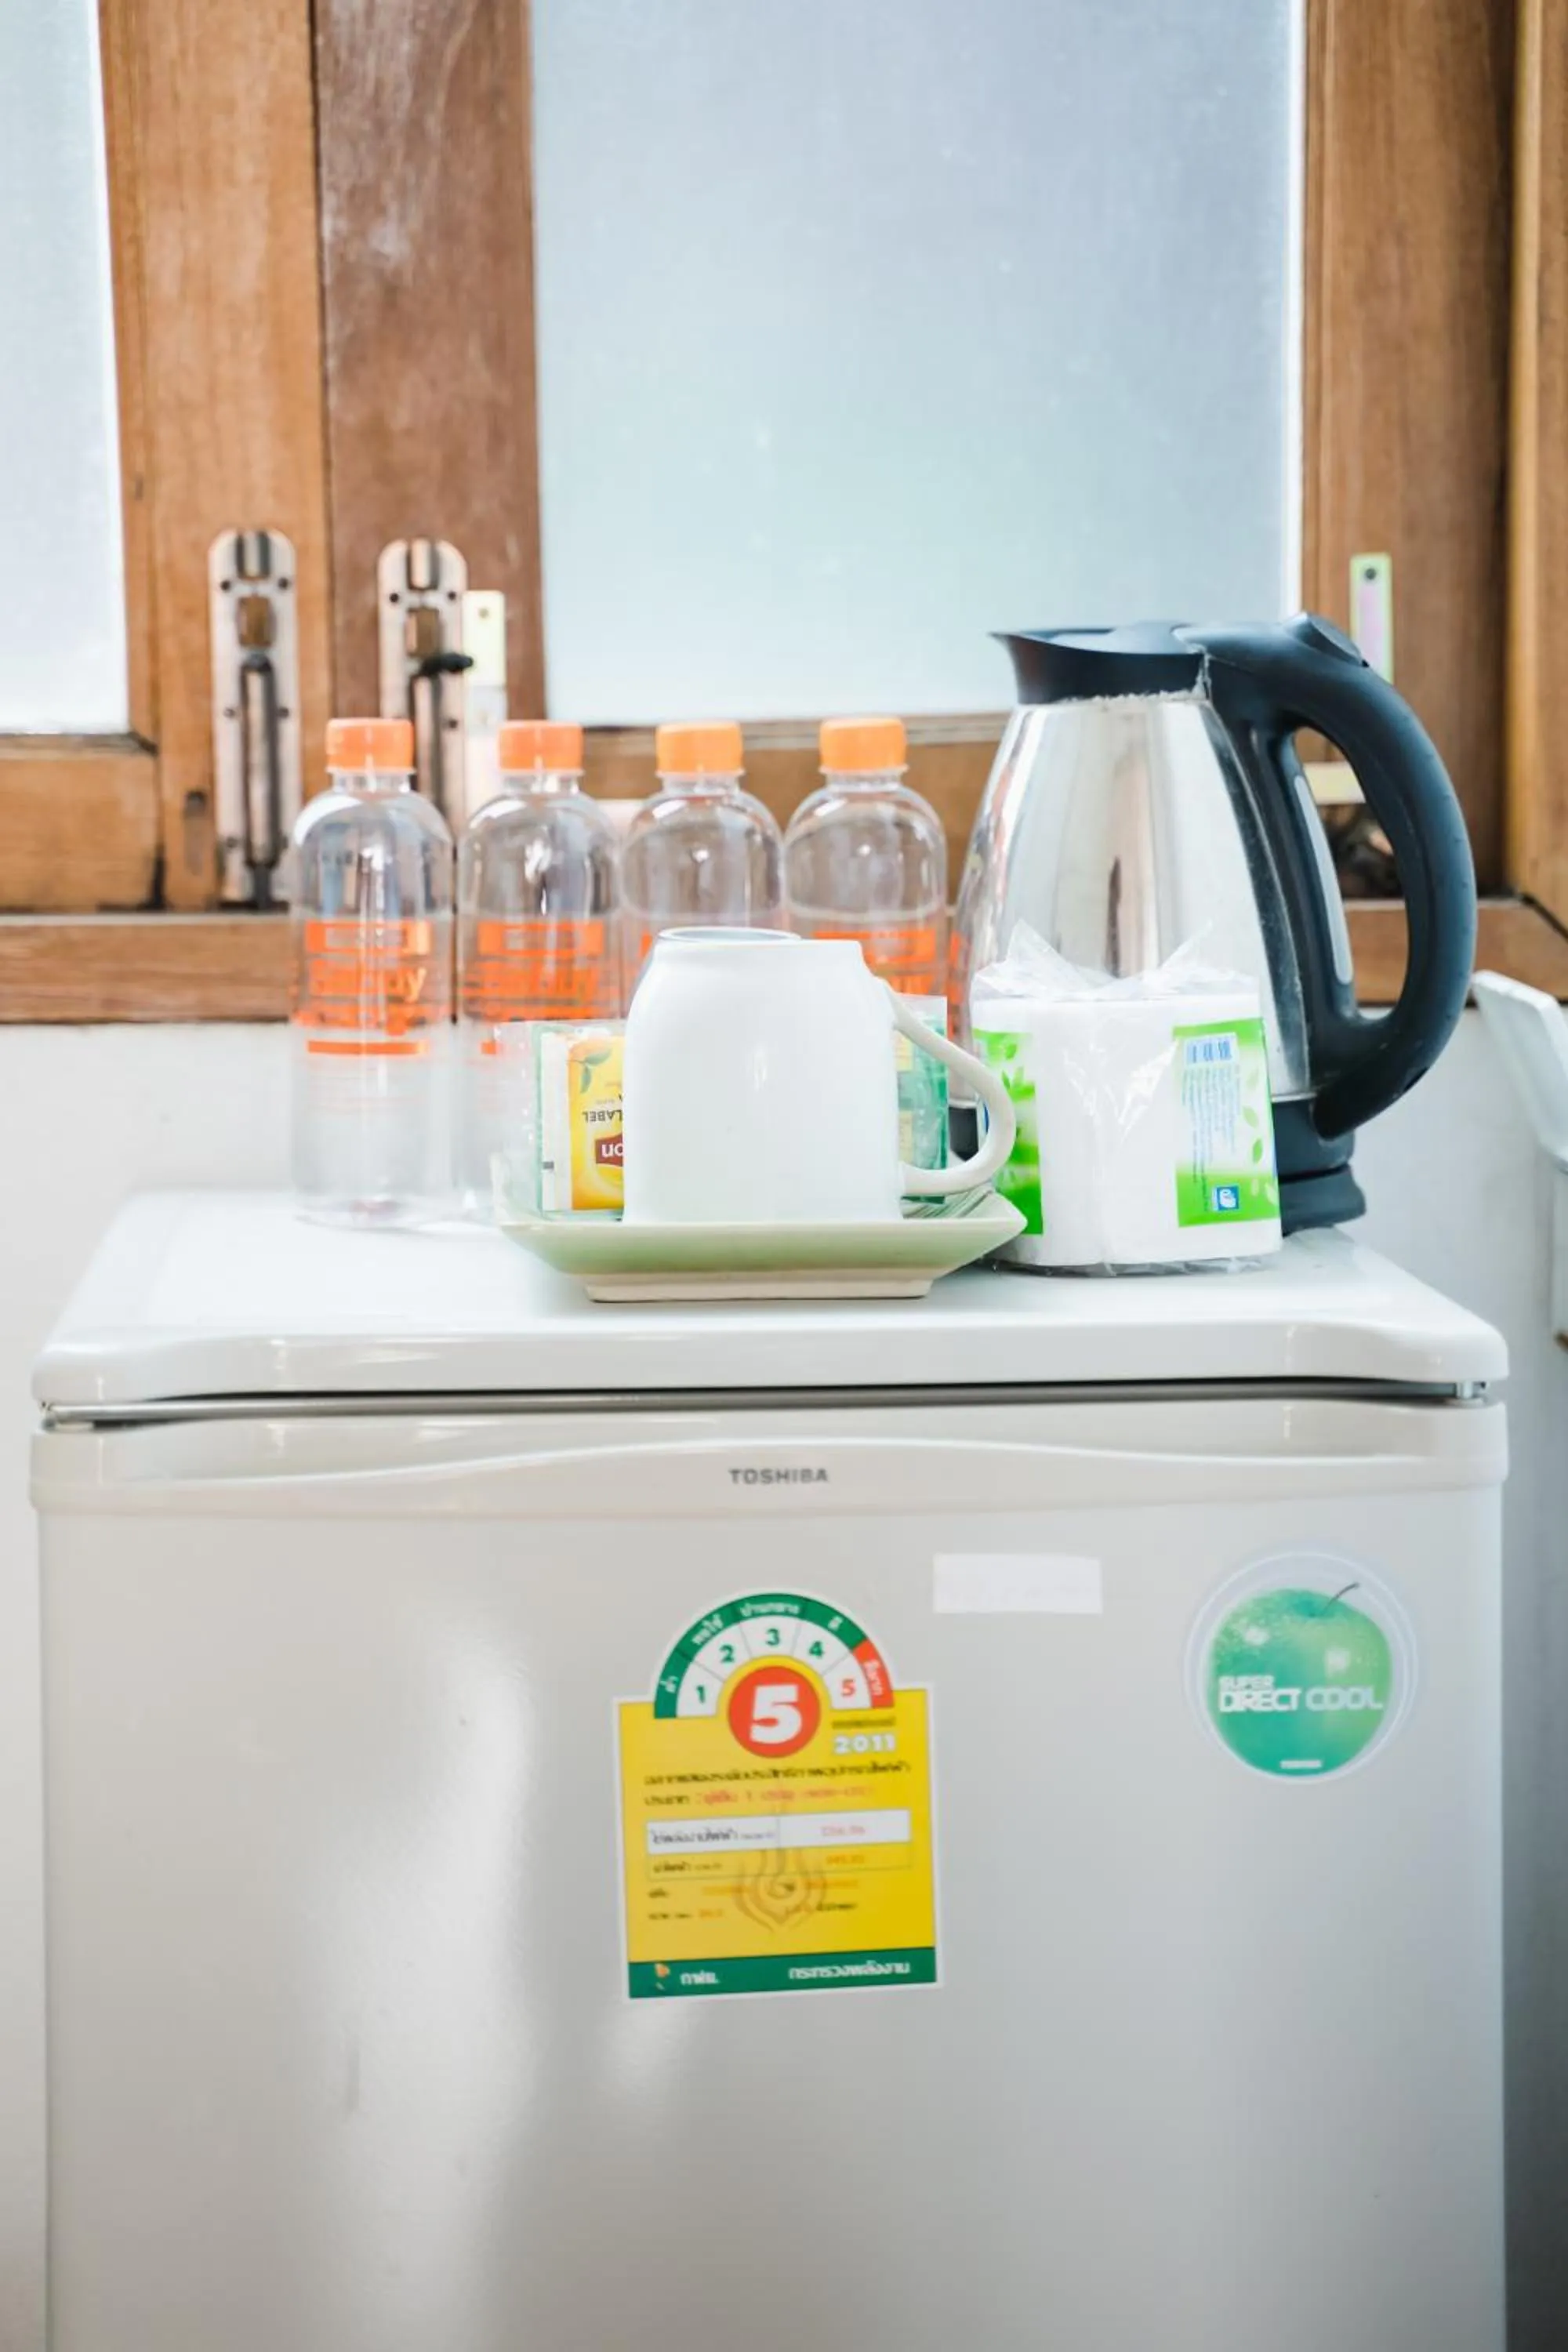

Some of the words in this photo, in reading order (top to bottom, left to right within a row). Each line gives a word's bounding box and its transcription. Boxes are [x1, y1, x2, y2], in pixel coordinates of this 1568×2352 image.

[582, 1110, 622, 1123] LABEL
[728, 1468, 829, 1484] TOSHIBA
[696, 1685, 706, 1704] 1
[720, 1645, 735, 1663] 2
[765, 1628, 780, 1646] 3
[808, 1641, 825, 1658] 4
[840, 1679, 855, 1697] 5
[1219, 1688, 1301, 1712] DIRECT
[1305, 1687, 1383, 1711] COOL
[750, 1683, 803, 1744] 5
[833, 1733, 896, 1755] 2011
